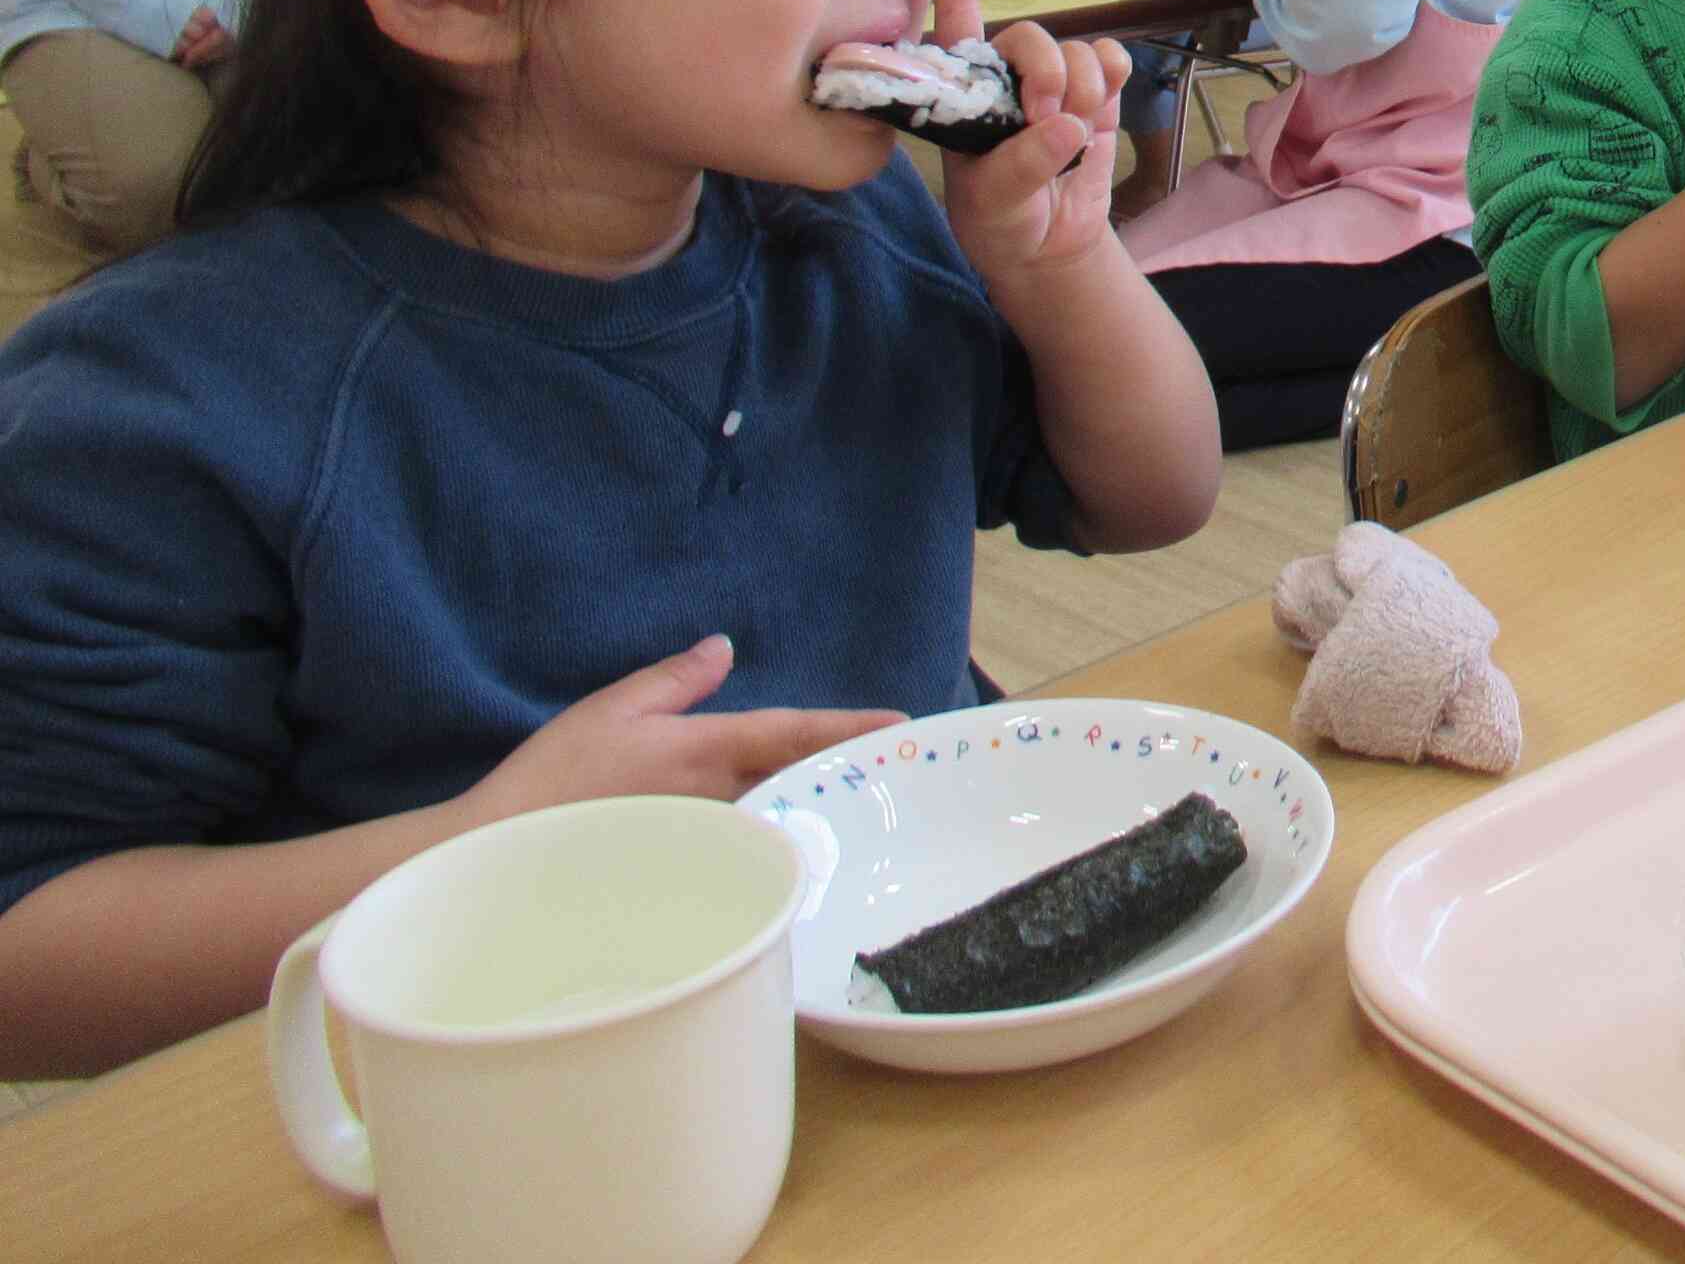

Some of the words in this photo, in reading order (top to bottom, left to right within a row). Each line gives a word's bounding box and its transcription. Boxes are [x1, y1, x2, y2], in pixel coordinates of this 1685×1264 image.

[840, 763, 867, 791] N
[898, 739, 919, 761] O
[956, 739, 970, 760] P
[1016, 722, 1043, 742] Q
[1136, 736, 1153, 758] S
[1191, 735, 1206, 756] T
